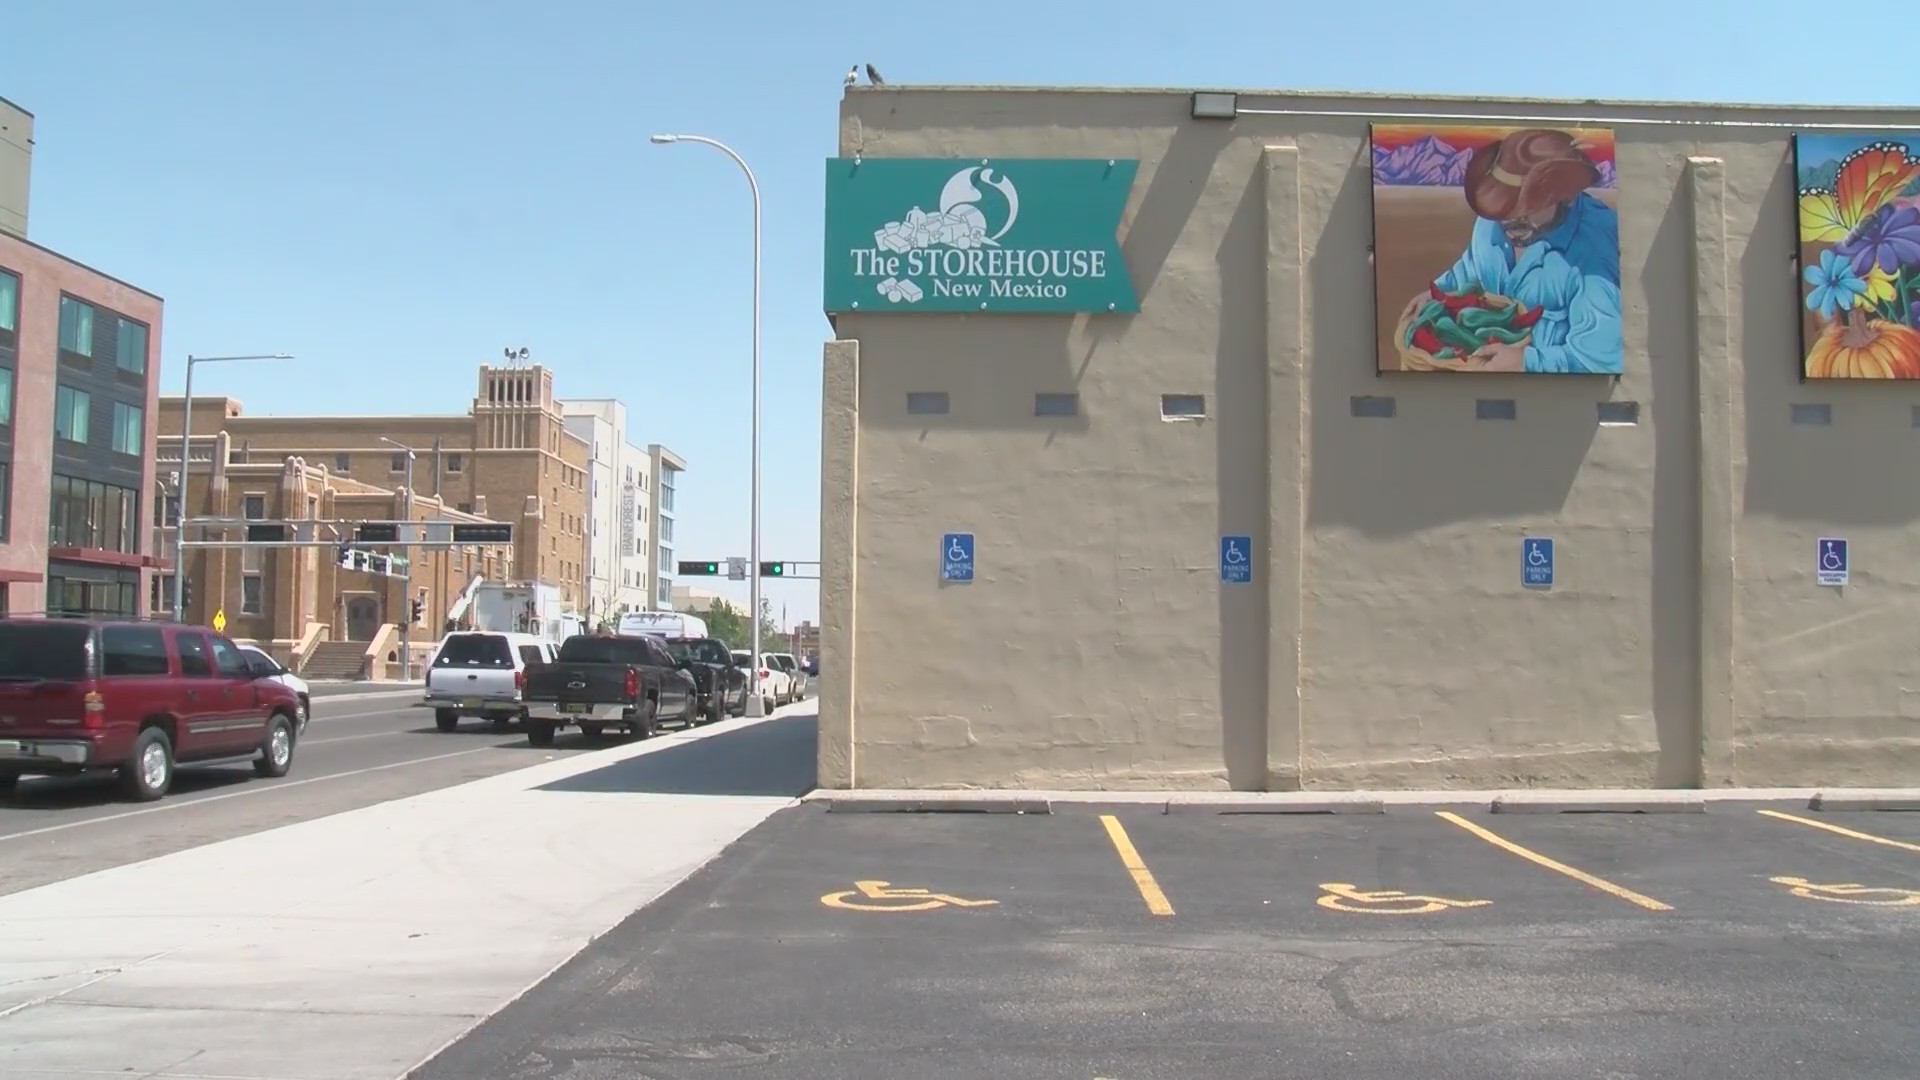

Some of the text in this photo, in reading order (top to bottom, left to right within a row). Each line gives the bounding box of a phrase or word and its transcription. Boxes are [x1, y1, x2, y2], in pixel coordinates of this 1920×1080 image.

[850, 248, 1106, 278] The STOREHOUSE
[932, 278, 1067, 298] New Mexico
[622, 495, 634, 551] RAINFOREST
[1526, 566, 1551, 574] PARKING
[1530, 573, 1547, 581] ONLY
